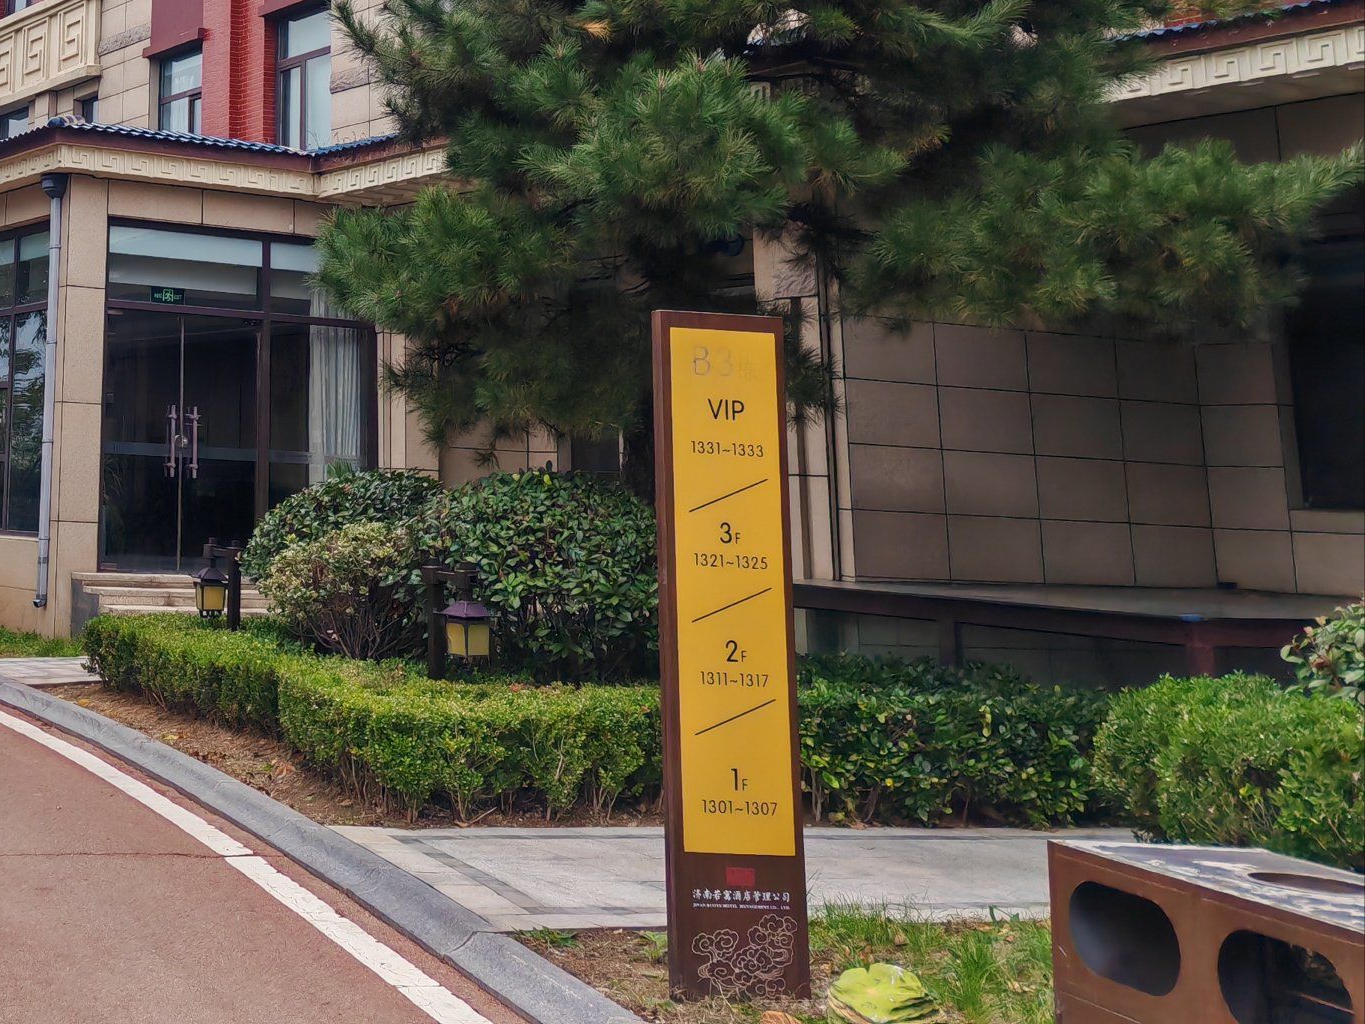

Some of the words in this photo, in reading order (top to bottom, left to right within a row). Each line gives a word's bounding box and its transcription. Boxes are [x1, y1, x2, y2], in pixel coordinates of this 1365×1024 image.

[707, 397, 745, 421] VIP
[690, 440, 764, 458] 1331~1333
[719, 521, 741, 544] 3F
[693, 552, 768, 570] 1321~1325
[725, 639, 747, 663] 2F
[700, 670, 769, 688] 1311~1317
[730, 767, 749, 792] 1F
[701, 799, 778, 817] 1301~1307
